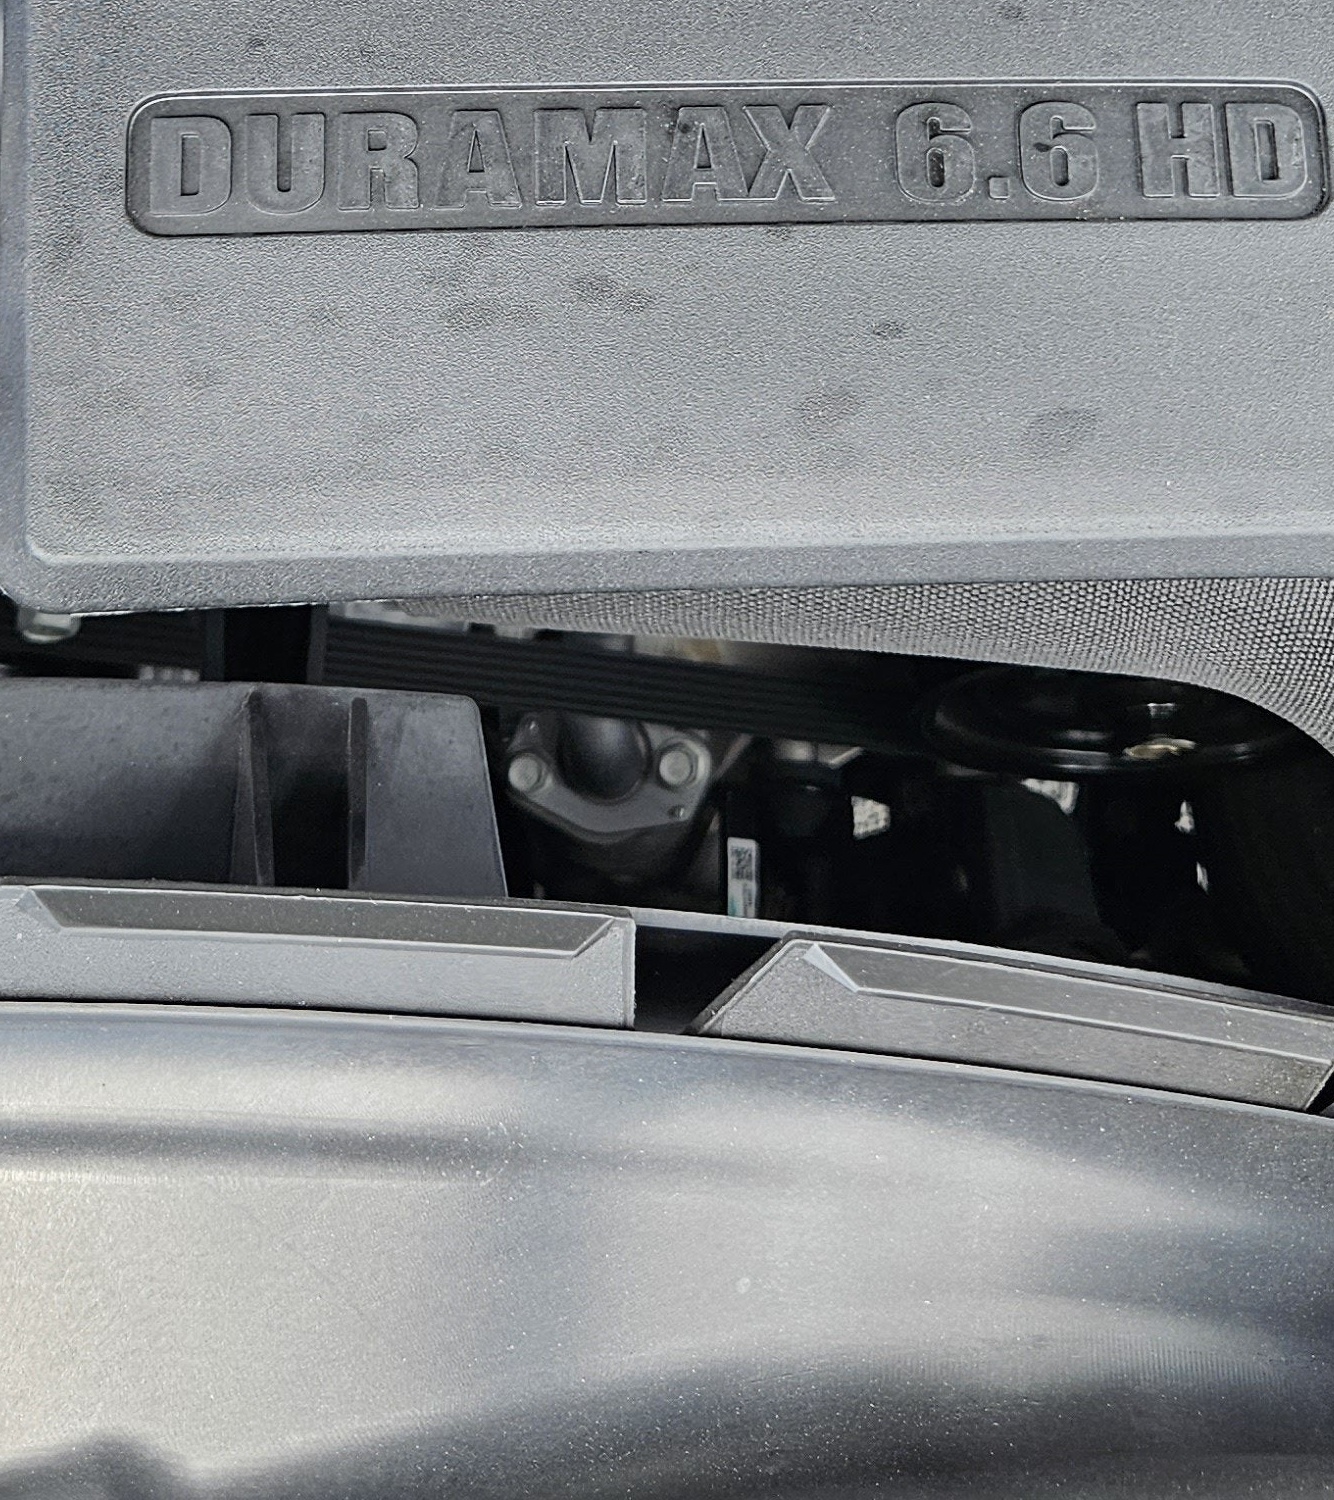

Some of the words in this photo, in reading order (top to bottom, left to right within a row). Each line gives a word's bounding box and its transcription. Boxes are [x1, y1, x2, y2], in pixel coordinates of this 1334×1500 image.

[149, 103, 838, 218] DURAMAX
[893, 100, 1100, 206] 6.6
[1135, 99, 1309, 203] HD
